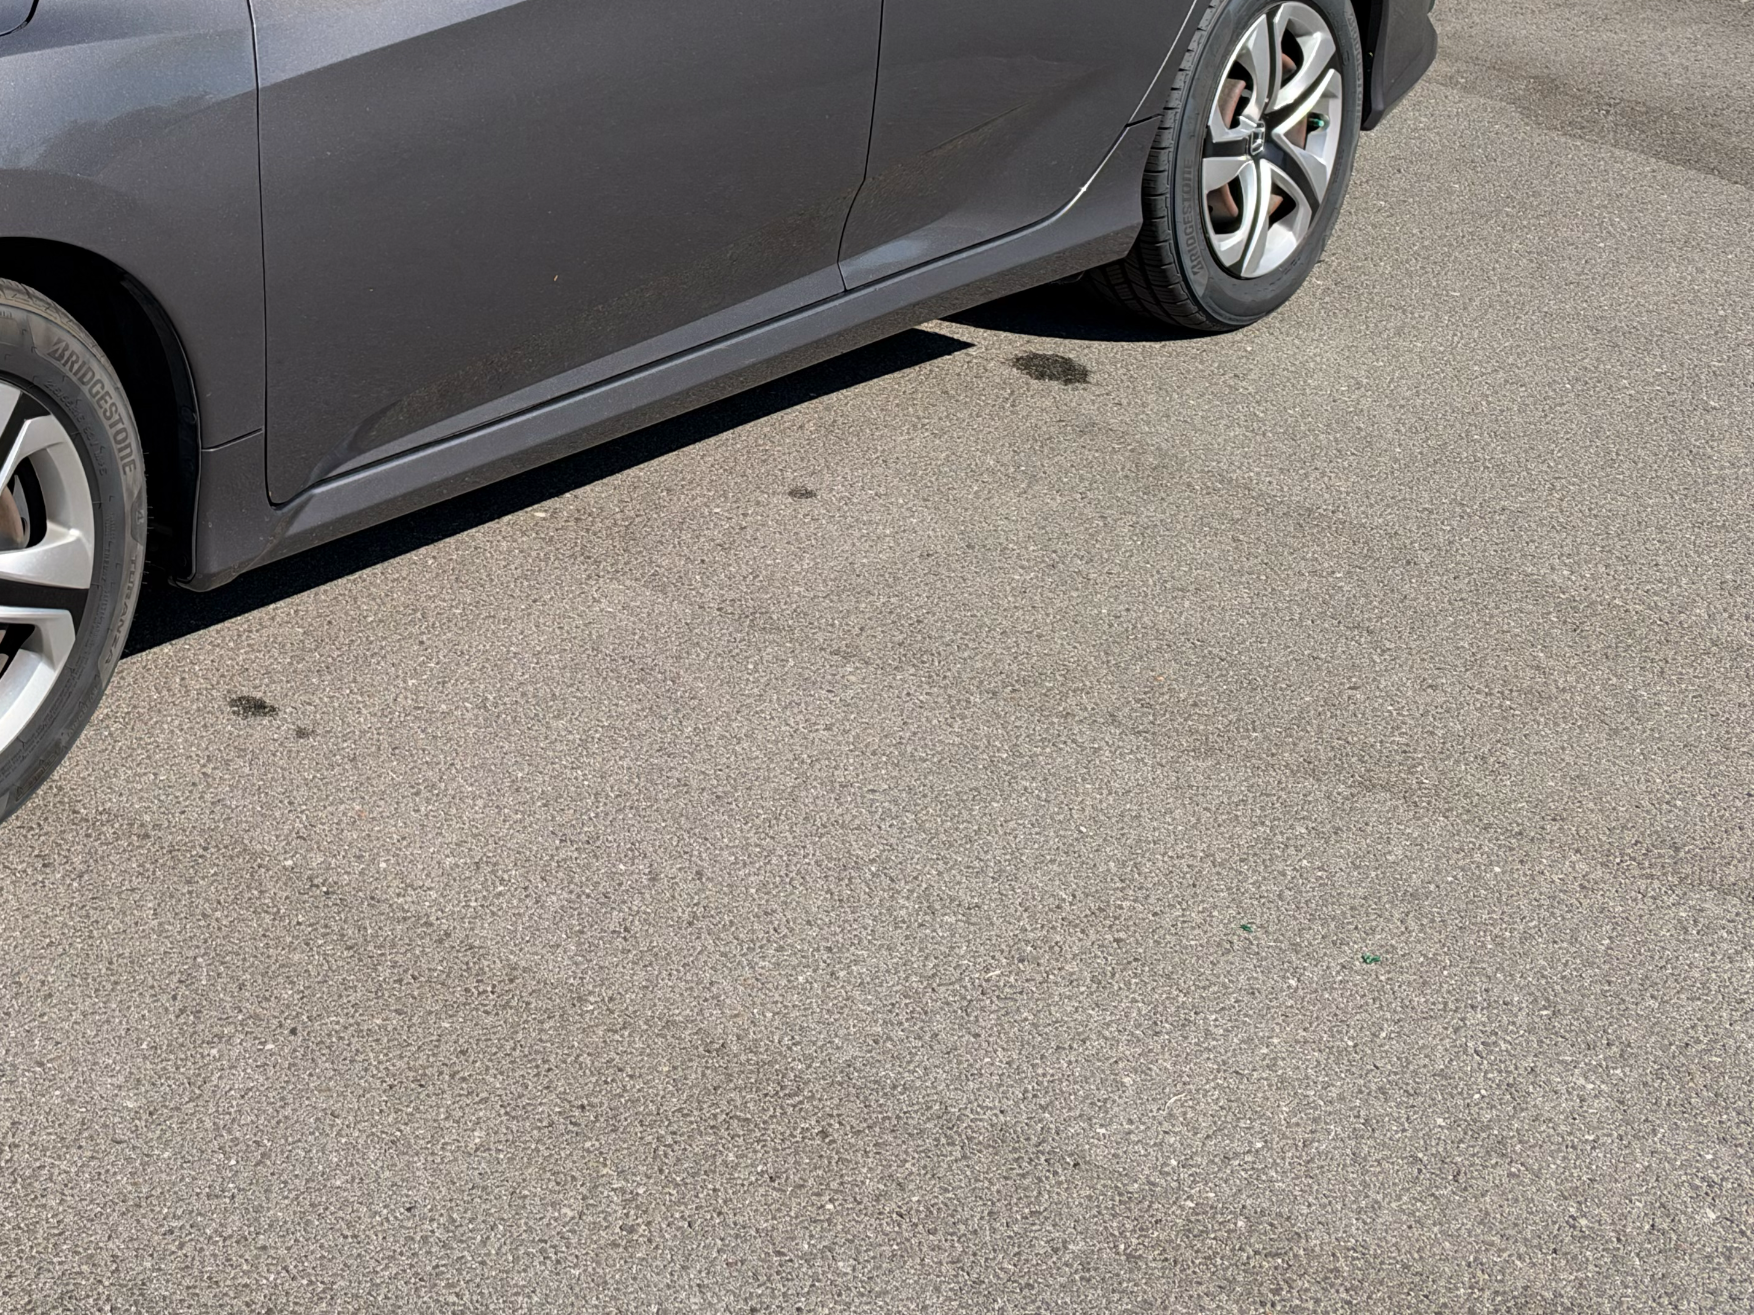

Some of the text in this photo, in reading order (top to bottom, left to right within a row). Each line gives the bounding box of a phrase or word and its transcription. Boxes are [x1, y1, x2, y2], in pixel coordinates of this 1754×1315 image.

[1182, 158, 1204, 276] BRIDGESTONE
[47, 337, 137, 476] BRIDGESTONE
[105, 557, 138, 665] TURANZA
